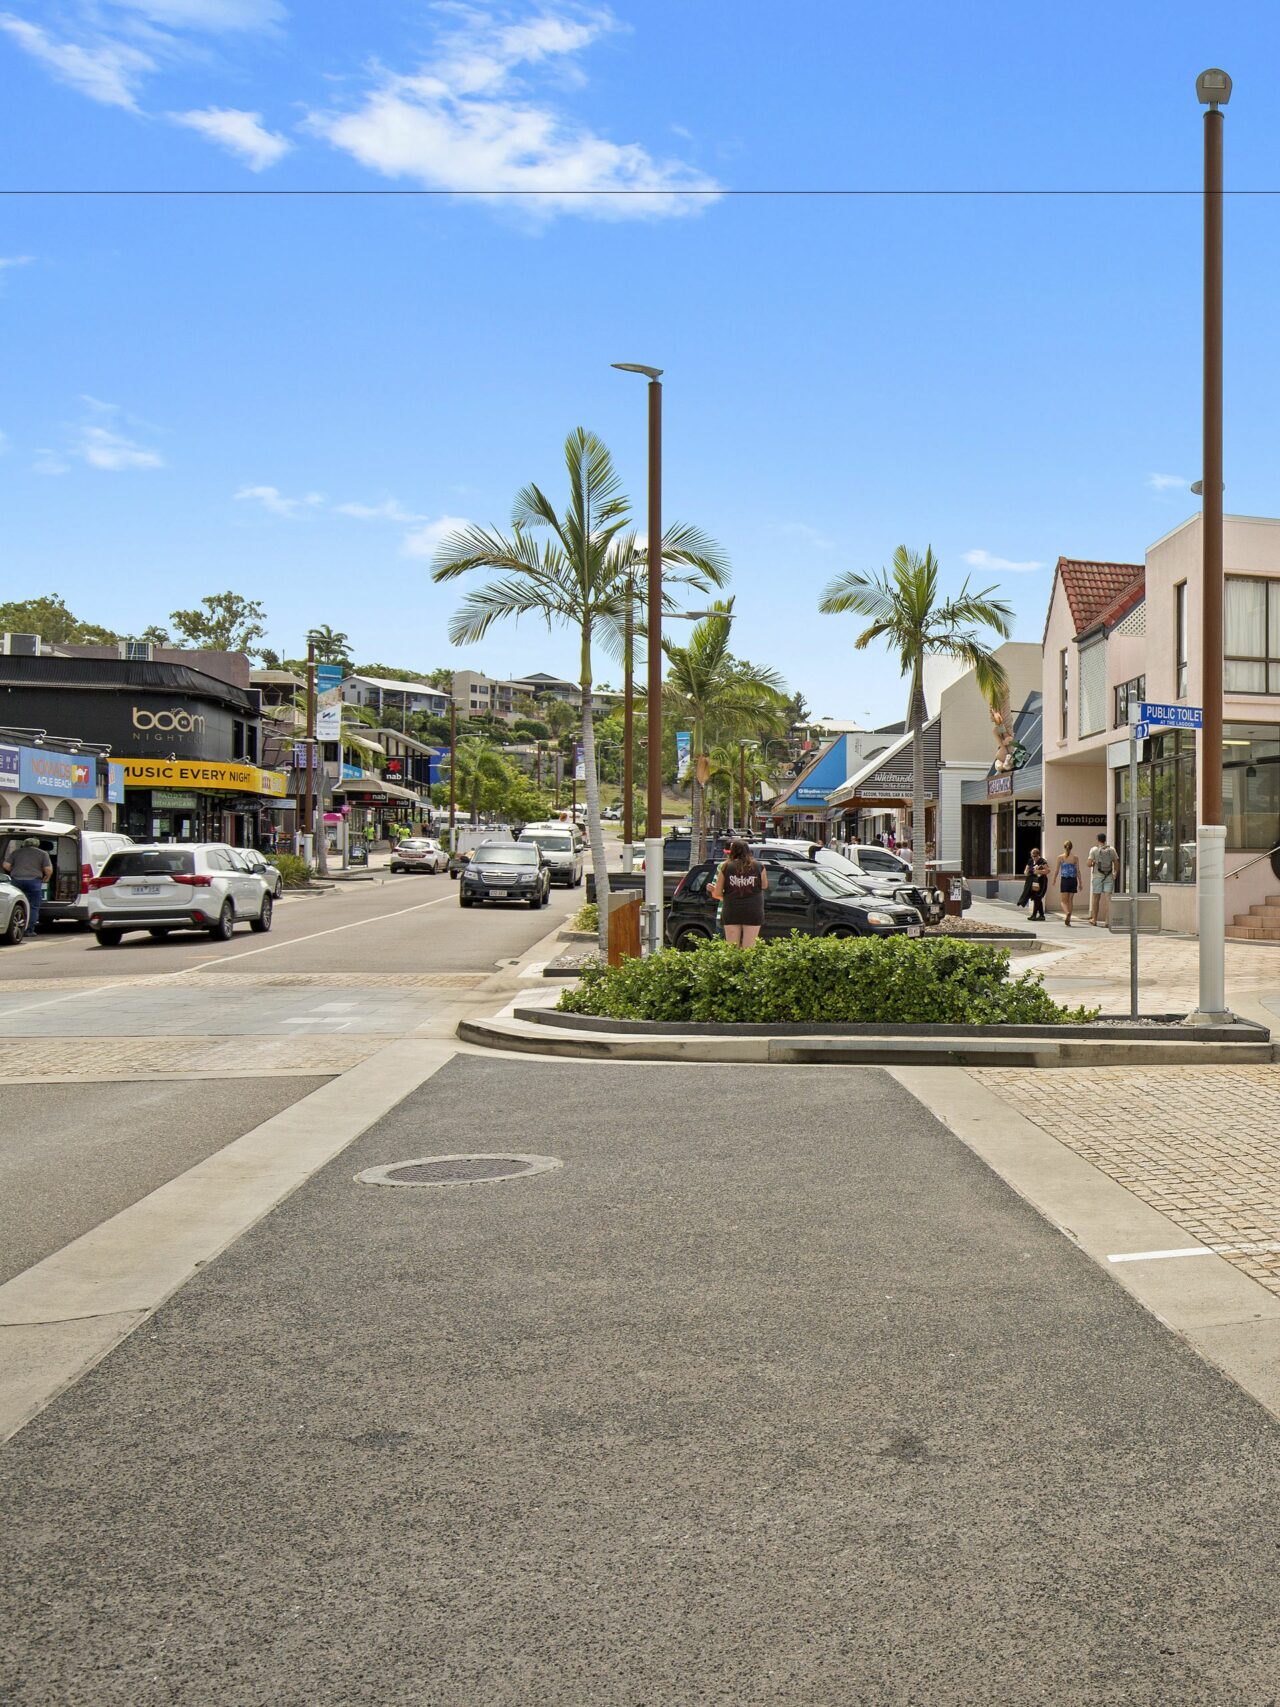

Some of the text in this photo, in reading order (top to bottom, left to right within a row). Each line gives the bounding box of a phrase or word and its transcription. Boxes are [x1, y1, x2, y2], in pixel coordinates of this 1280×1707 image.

[1147, 706, 1175, 719] PUBLIC
[132, 707, 205, 735] boom
[180, 768, 226, 781] EVERY
[229, 771, 251, 783] NIGHT
